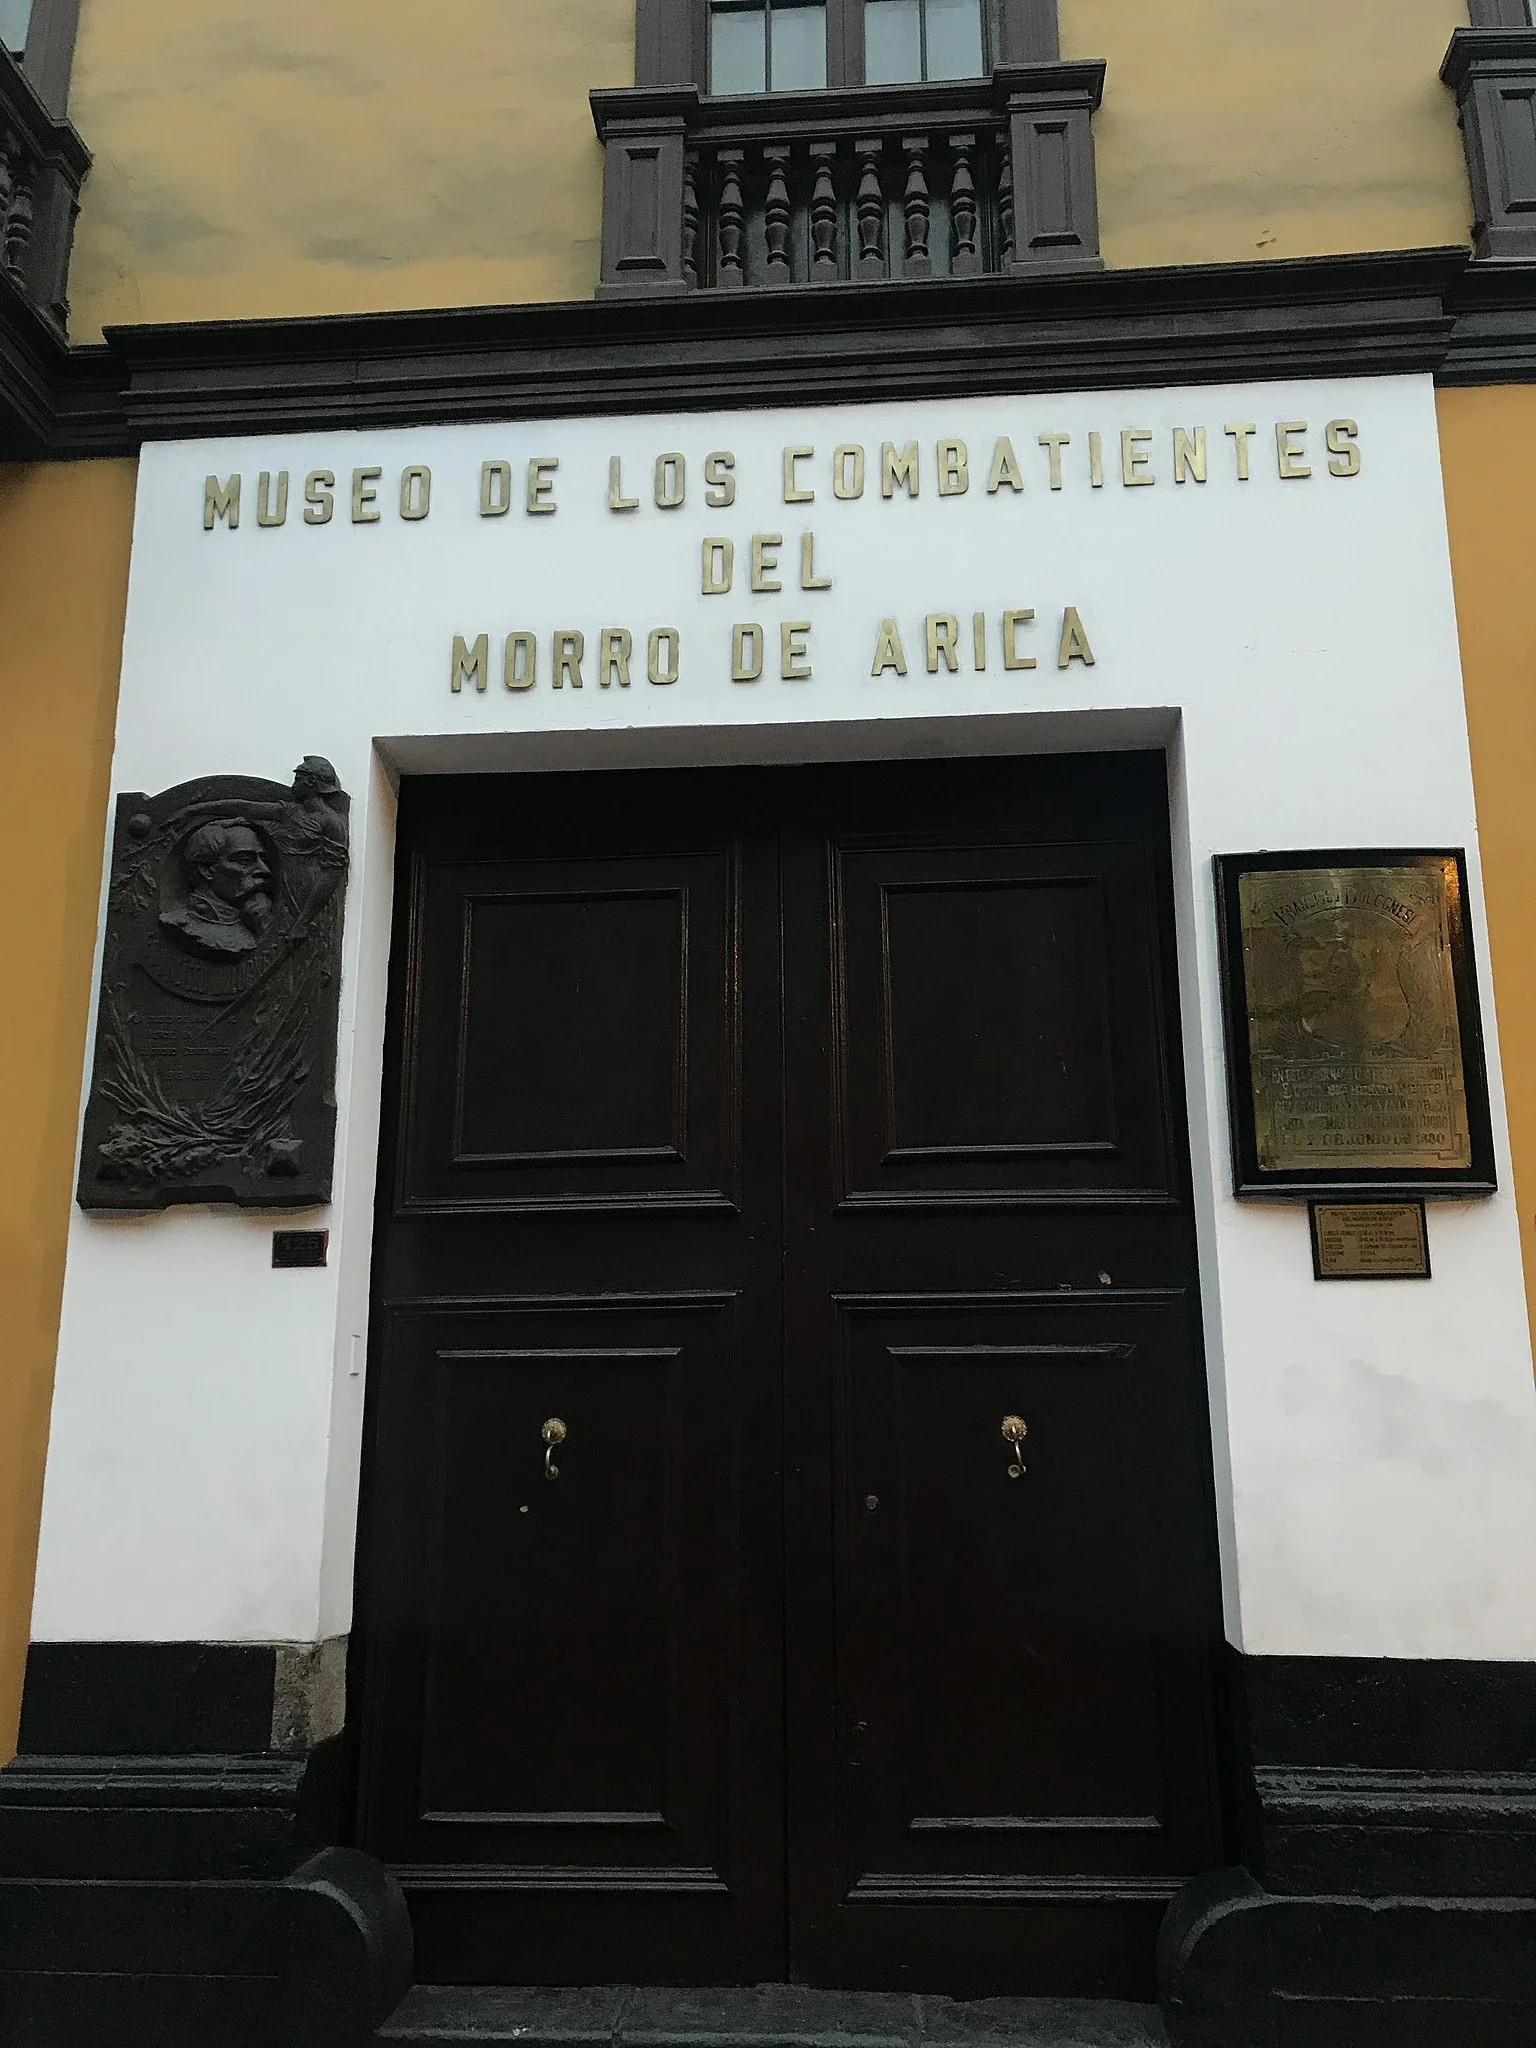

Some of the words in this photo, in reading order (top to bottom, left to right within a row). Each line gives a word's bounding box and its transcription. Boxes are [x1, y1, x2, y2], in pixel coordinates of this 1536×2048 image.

[203, 465, 431, 529] MUSEO
[480, 457, 559, 517] DE
[609, 450, 737, 509] LOS
[783, 419, 1361, 503] COMBATIENTES
[701, 531, 832, 595] DEL
[451, 627, 681, 693] MORRO
[731, 620, 813, 681] DE
[871, 606, 1096, 678] ARICA
